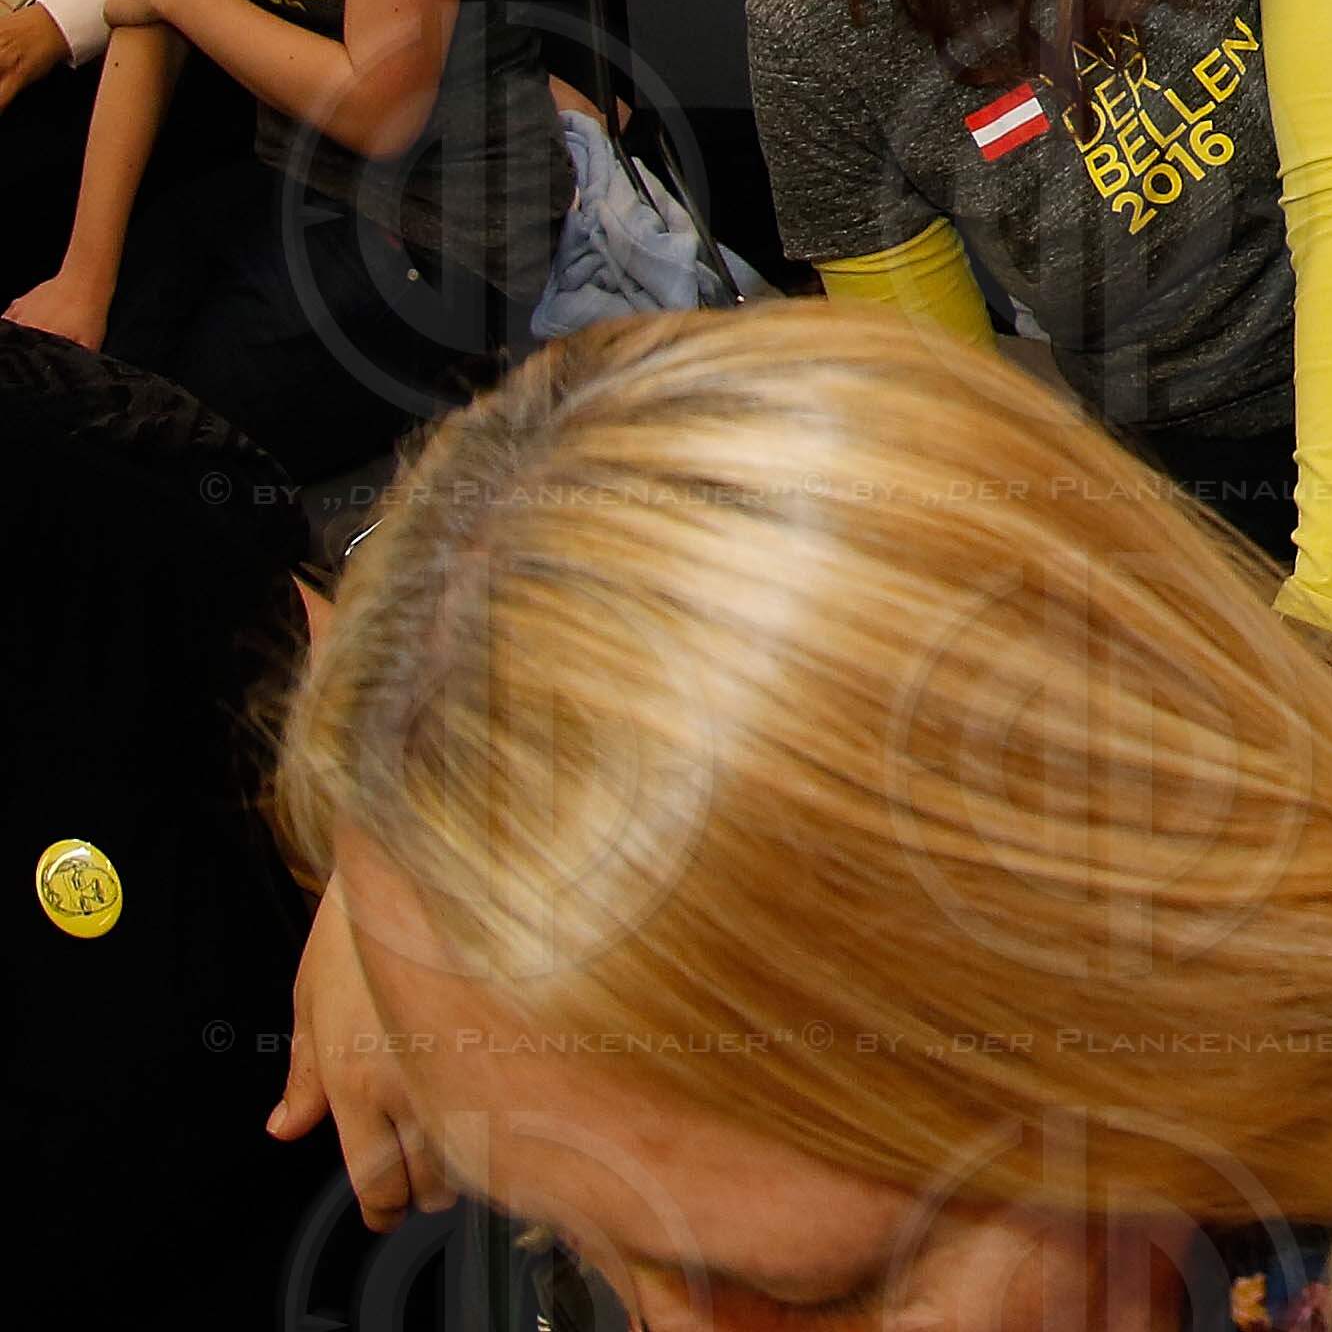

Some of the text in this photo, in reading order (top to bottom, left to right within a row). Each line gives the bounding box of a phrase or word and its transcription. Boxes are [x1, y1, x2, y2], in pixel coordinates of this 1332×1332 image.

[1062, 52, 1160, 153] DER
[1085, 16, 1260, 199] BELLEN
[1111, 120, 1235, 235] 2016
